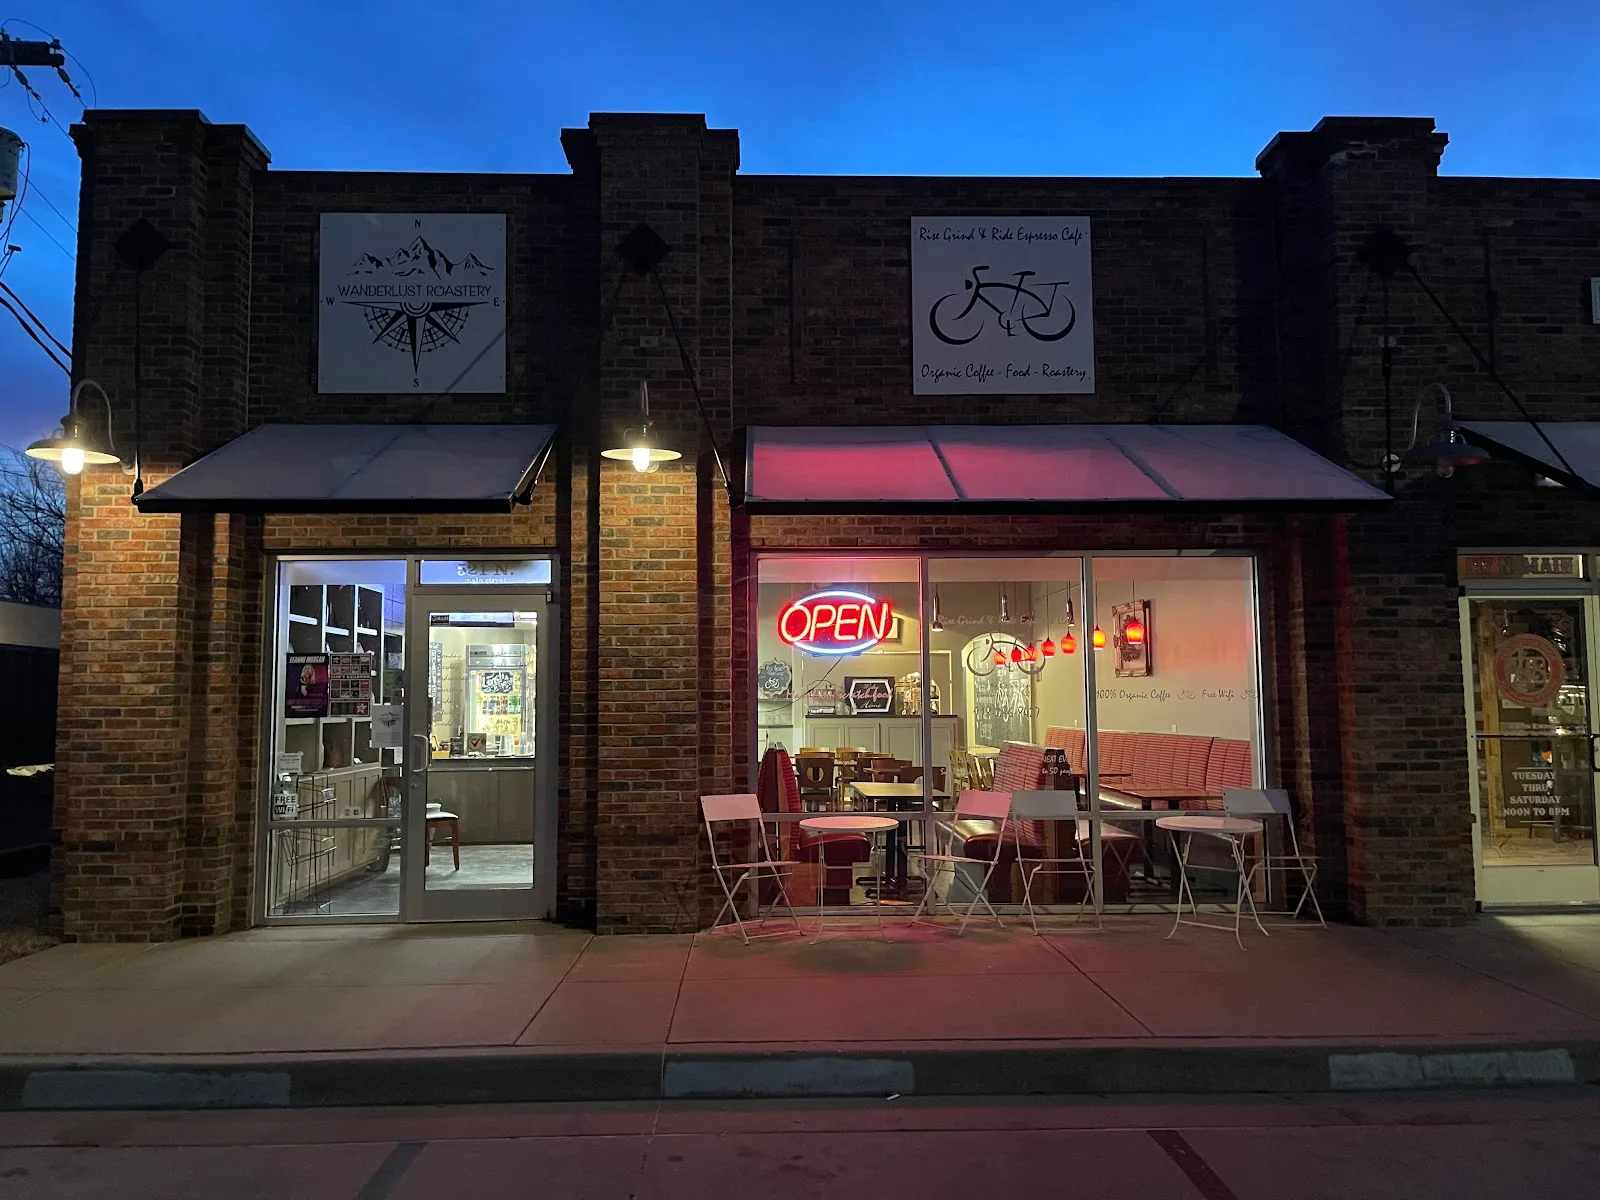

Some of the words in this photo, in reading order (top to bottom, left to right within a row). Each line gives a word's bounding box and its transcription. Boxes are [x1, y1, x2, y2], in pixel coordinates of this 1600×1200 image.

[414, 219, 421, 228] N
[919, 227, 940, 241] Rise
[943, 227, 975, 241] Grind
[979, 228, 987, 240] &
[991, 227, 1014, 241] Ride
[1017, 227, 1058, 244] Espresso
[1061, 227, 1083, 245] Cafe
[338, 284, 422, 297] WANDERLUST
[426, 284, 492, 297] ROASTERY
[325, 297, 335, 306] W
[493, 297, 500, 307] E
[921, 364, 962, 383] Organic
[965, 363, 994, 383] Coffee
[1006, 363, 1031, 378] Food
[1042, 363, 1086, 382] Roastery
[413, 378, 419, 387] S
[456, 563, 487, 577] 521
[780, 602, 888, 642] OPEN
[1096, 690, 1116, 700] 100%
[1119, 690, 1148, 703] Organic
[1150, 689, 1171, 702] Coffee
[1202, 689, 1216, 699] Free
[1511, 771, 1557, 780] TUESDAY
[1521, 783, 1548, 792] THRU
[275, 795, 296, 804] FREE
[1509, 795, 1561, 804] SATURDAY
[1503, 807, 1531, 816] NOON
[1533, 807, 1546, 816] TO
[1548, 807, 1570, 816] 8PM
